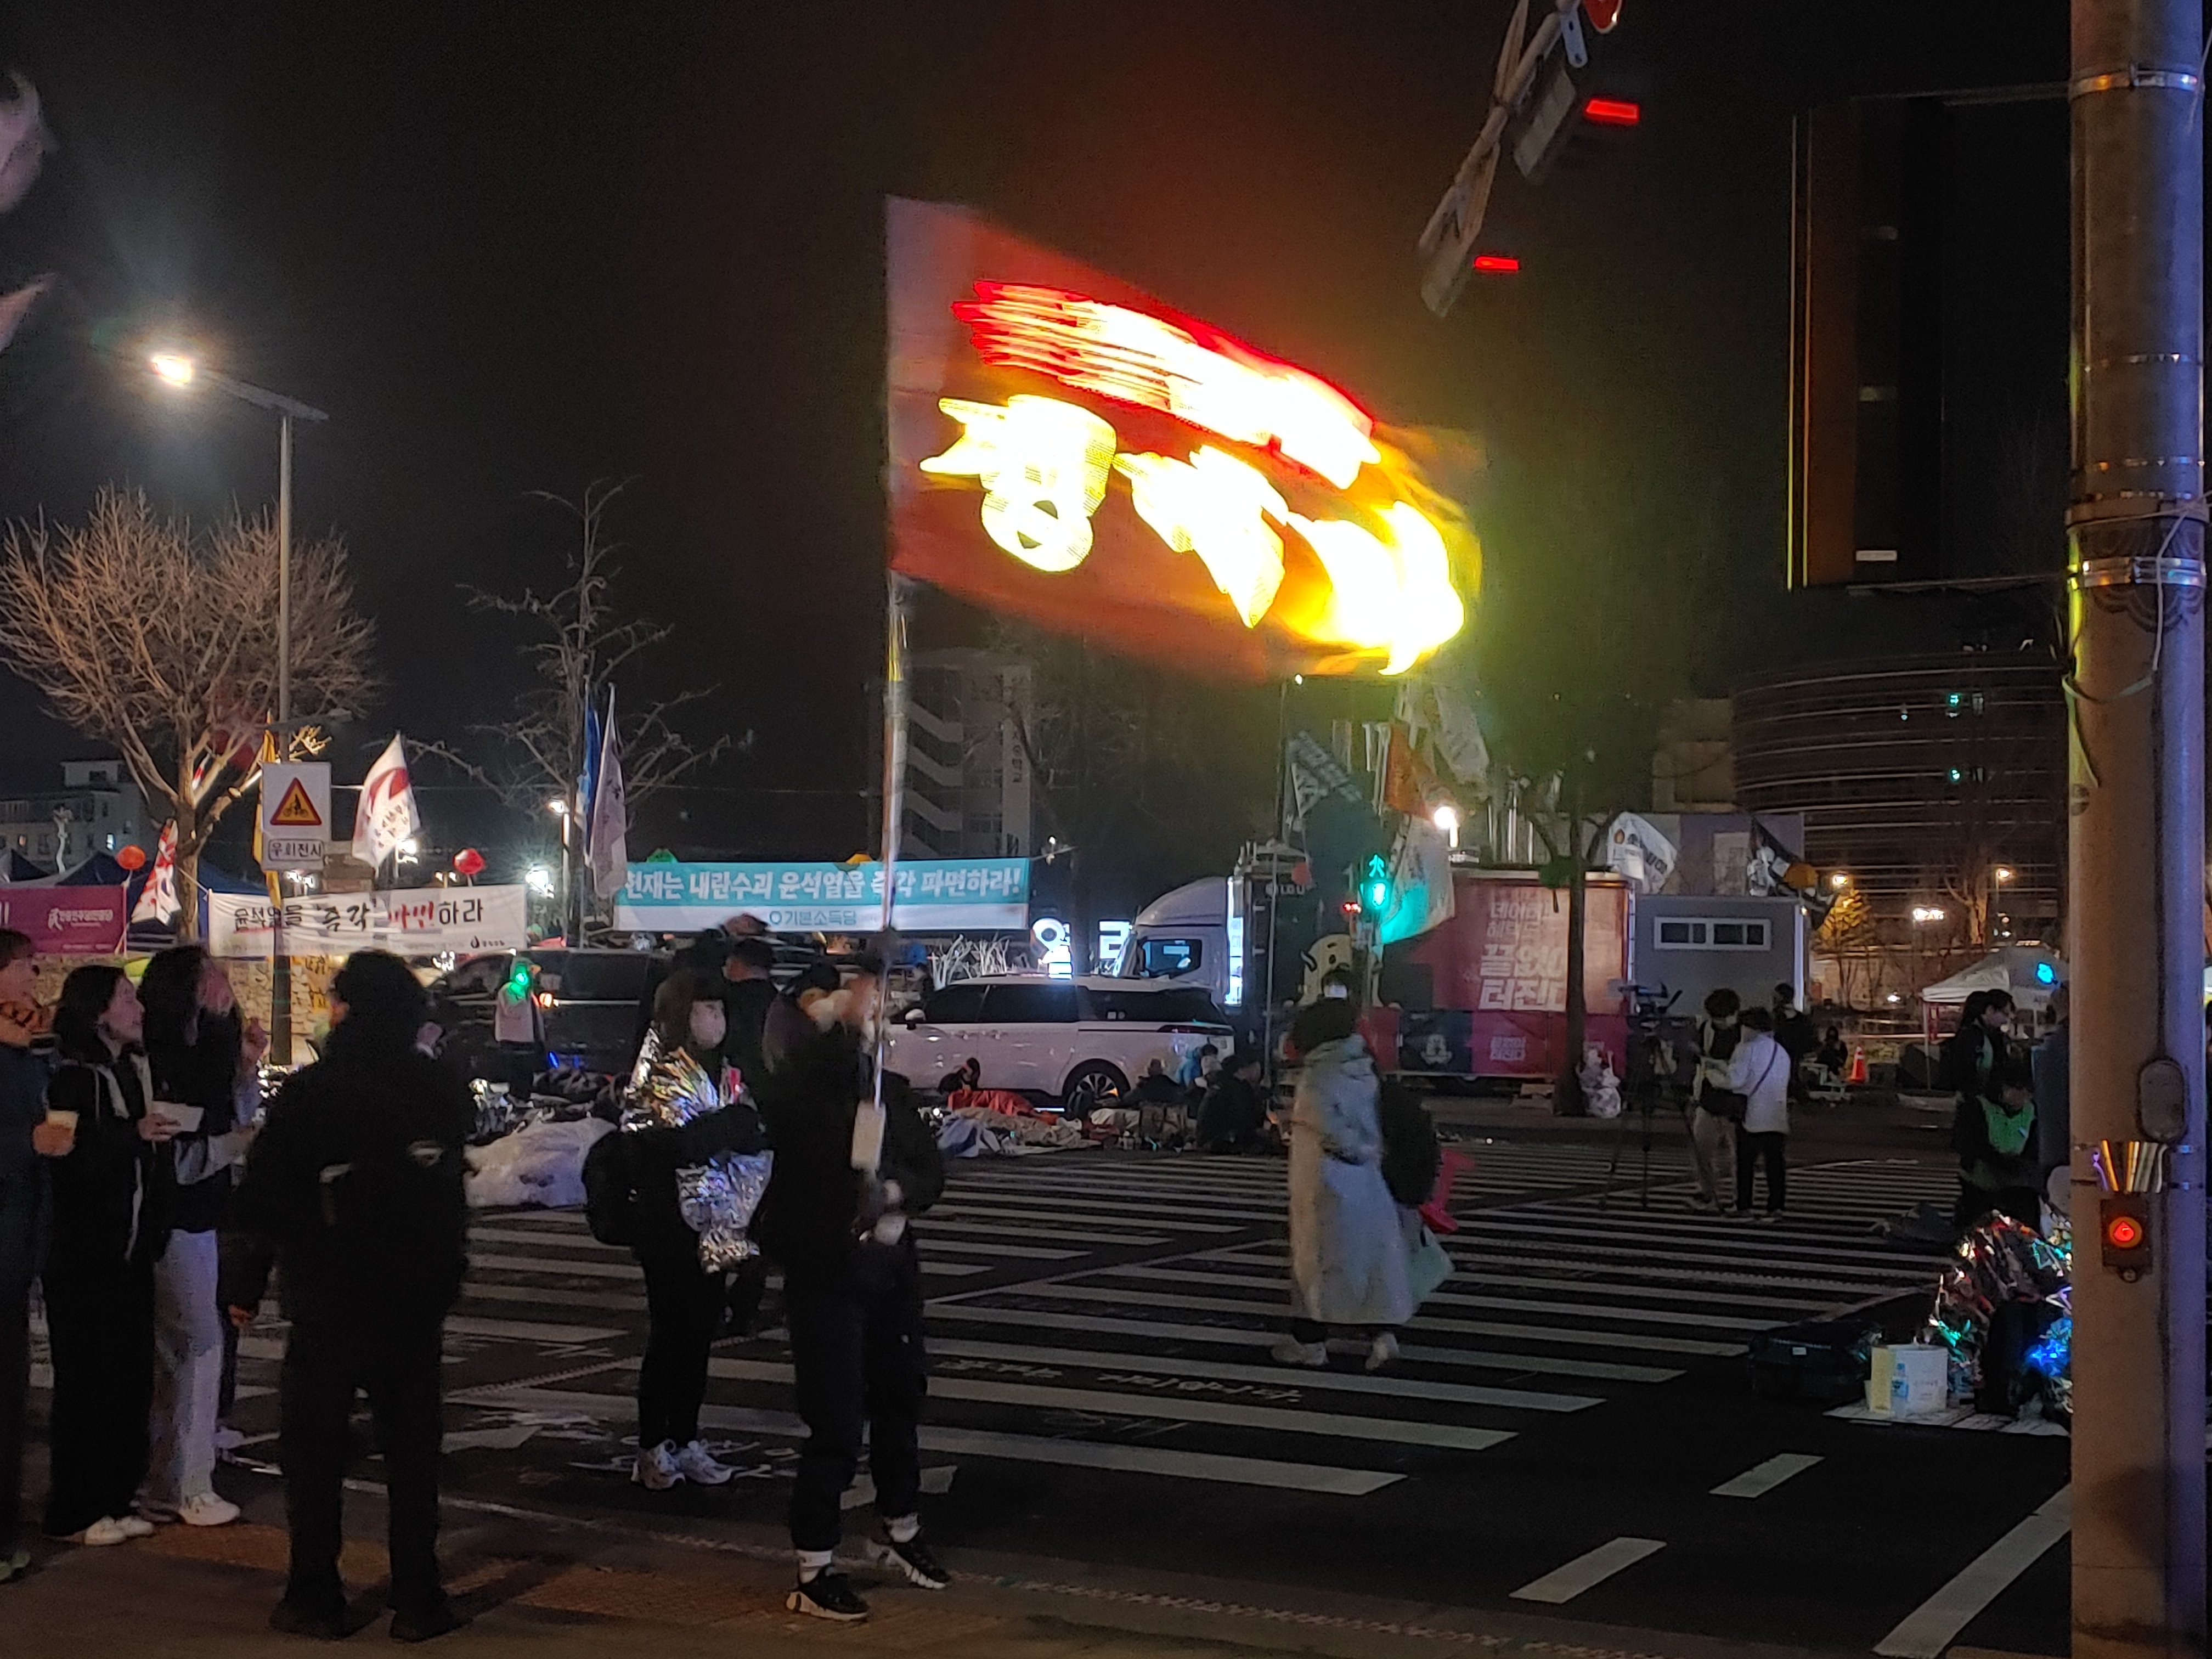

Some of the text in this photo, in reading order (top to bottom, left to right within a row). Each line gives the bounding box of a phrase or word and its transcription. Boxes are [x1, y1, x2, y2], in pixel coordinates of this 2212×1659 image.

[625, 870, 684, 900] 헌재는
[690, 871, 774, 900] 내란수괴
[778, 870, 866, 900] 윤석열을
[920, 866, 1022, 898] 파면하라!
[785, 911, 857, 927] 기본소득당
